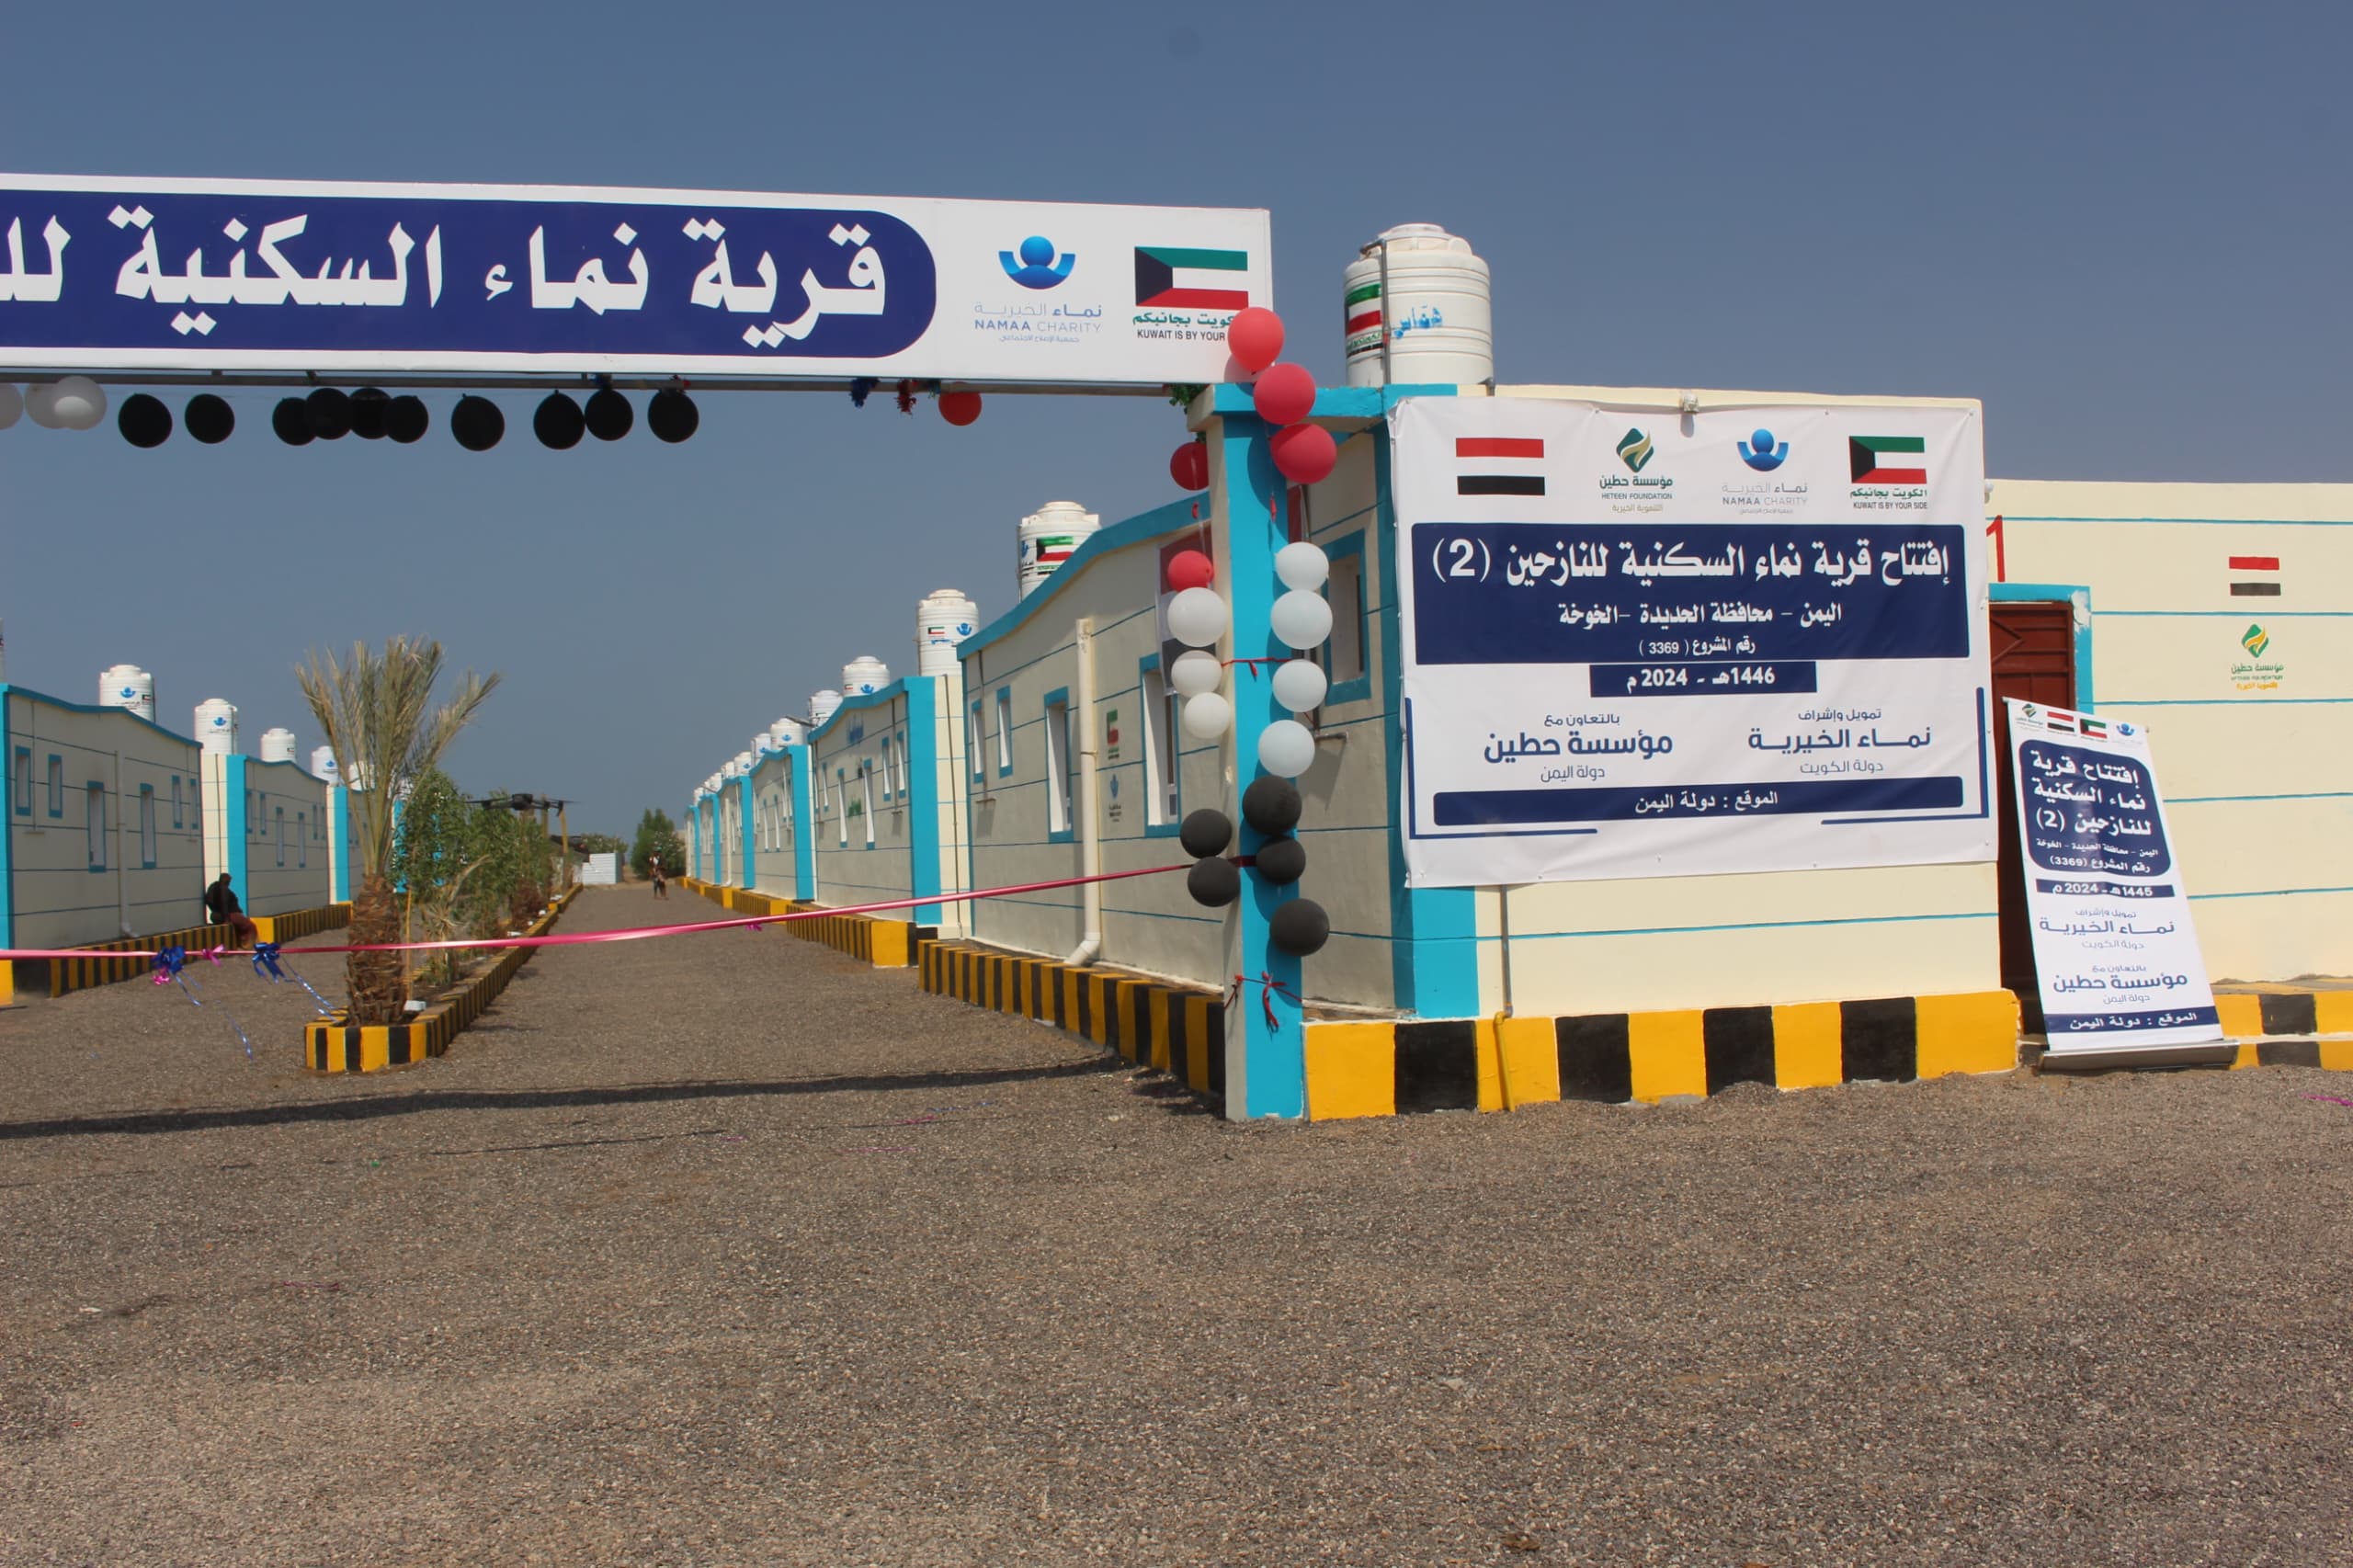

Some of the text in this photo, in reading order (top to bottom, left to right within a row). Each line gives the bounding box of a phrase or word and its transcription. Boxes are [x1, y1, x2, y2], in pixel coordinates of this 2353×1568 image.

[108, 204, 443, 335] السكنية
[485, 222, 649, 315] نماء
[682, 217, 886, 348] قرية
[974, 301, 1102, 318] نماء الخيرية
[974, 319, 1102, 333] NAMAA CHARITY
[1132, 312, 1235, 328] كويت بجانبكم
[1137, 329, 1225, 341] KUWAIT IS BY YOUR
[1599, 474, 1673, 490] مؤسسة حطين
[1774, 482, 1808, 493] نماء
[1722, 496, 1809, 506] NAMAA CHARITY
[1850, 487, 1927, 499] الكويت بجانبكم
[1853, 501, 1927, 509] KUWAIT IS BY YOUR SIDE
[1433, 538, 1949, 587] إفتتاح قرية نماء السكنية للنازحين (2)
[1640, 603, 1705, 630] الحديدة
[1711, 601, 1773, 622] محافظة
[1801, 601, 1842, 627] اليمن
[1692, 635, 1731, 655] المشروع
[1735, 635, 1756, 654] رقم
[1626, 676, 1637, 694] م
[1641, 668, 1688, 687] 2024
[1544, 713, 1620, 727] بالتعاون مع
[1798, 707, 1881, 722] تمويل وإشراف
[1484, 729, 1673, 764] مؤسسة حطين
[1748, 726, 1932, 754] نماء الخيرية
[1540, 765, 1605, 782] دولة اليمن
[1800, 758, 1883, 775] دولة الكويت
[2030, 749, 2140, 790] إفتتاح قرية
[1679, 790, 1716, 810] دولة
[1734, 790, 1779, 812] الموقع
[2031, 777, 2146, 810] نماء السكنية
[1635, 792, 1674, 813] اليمن
[2036, 806, 2152, 836] للنازحين (2)
[2139, 848, 2158, 858] اليمن
[2091, 858, 2128, 870] المشروع
[2131, 861, 2151, 873] رقم
[2052, 883, 2063, 895] م
[2064, 883, 2098, 893] 2024
[2040, 917, 2175, 936] نماء الخيرية
[2082, 938, 2144, 950] دولة الكويت
[2053, 973, 2188, 994] مؤسسة حطين
[2103, 994, 2151, 1006] دولة اليمن
[2070, 1017, 2104, 1030] اليمن
[2109, 1015, 2141, 1028] دولة
[2158, 1012, 2198, 1027] الموقع
